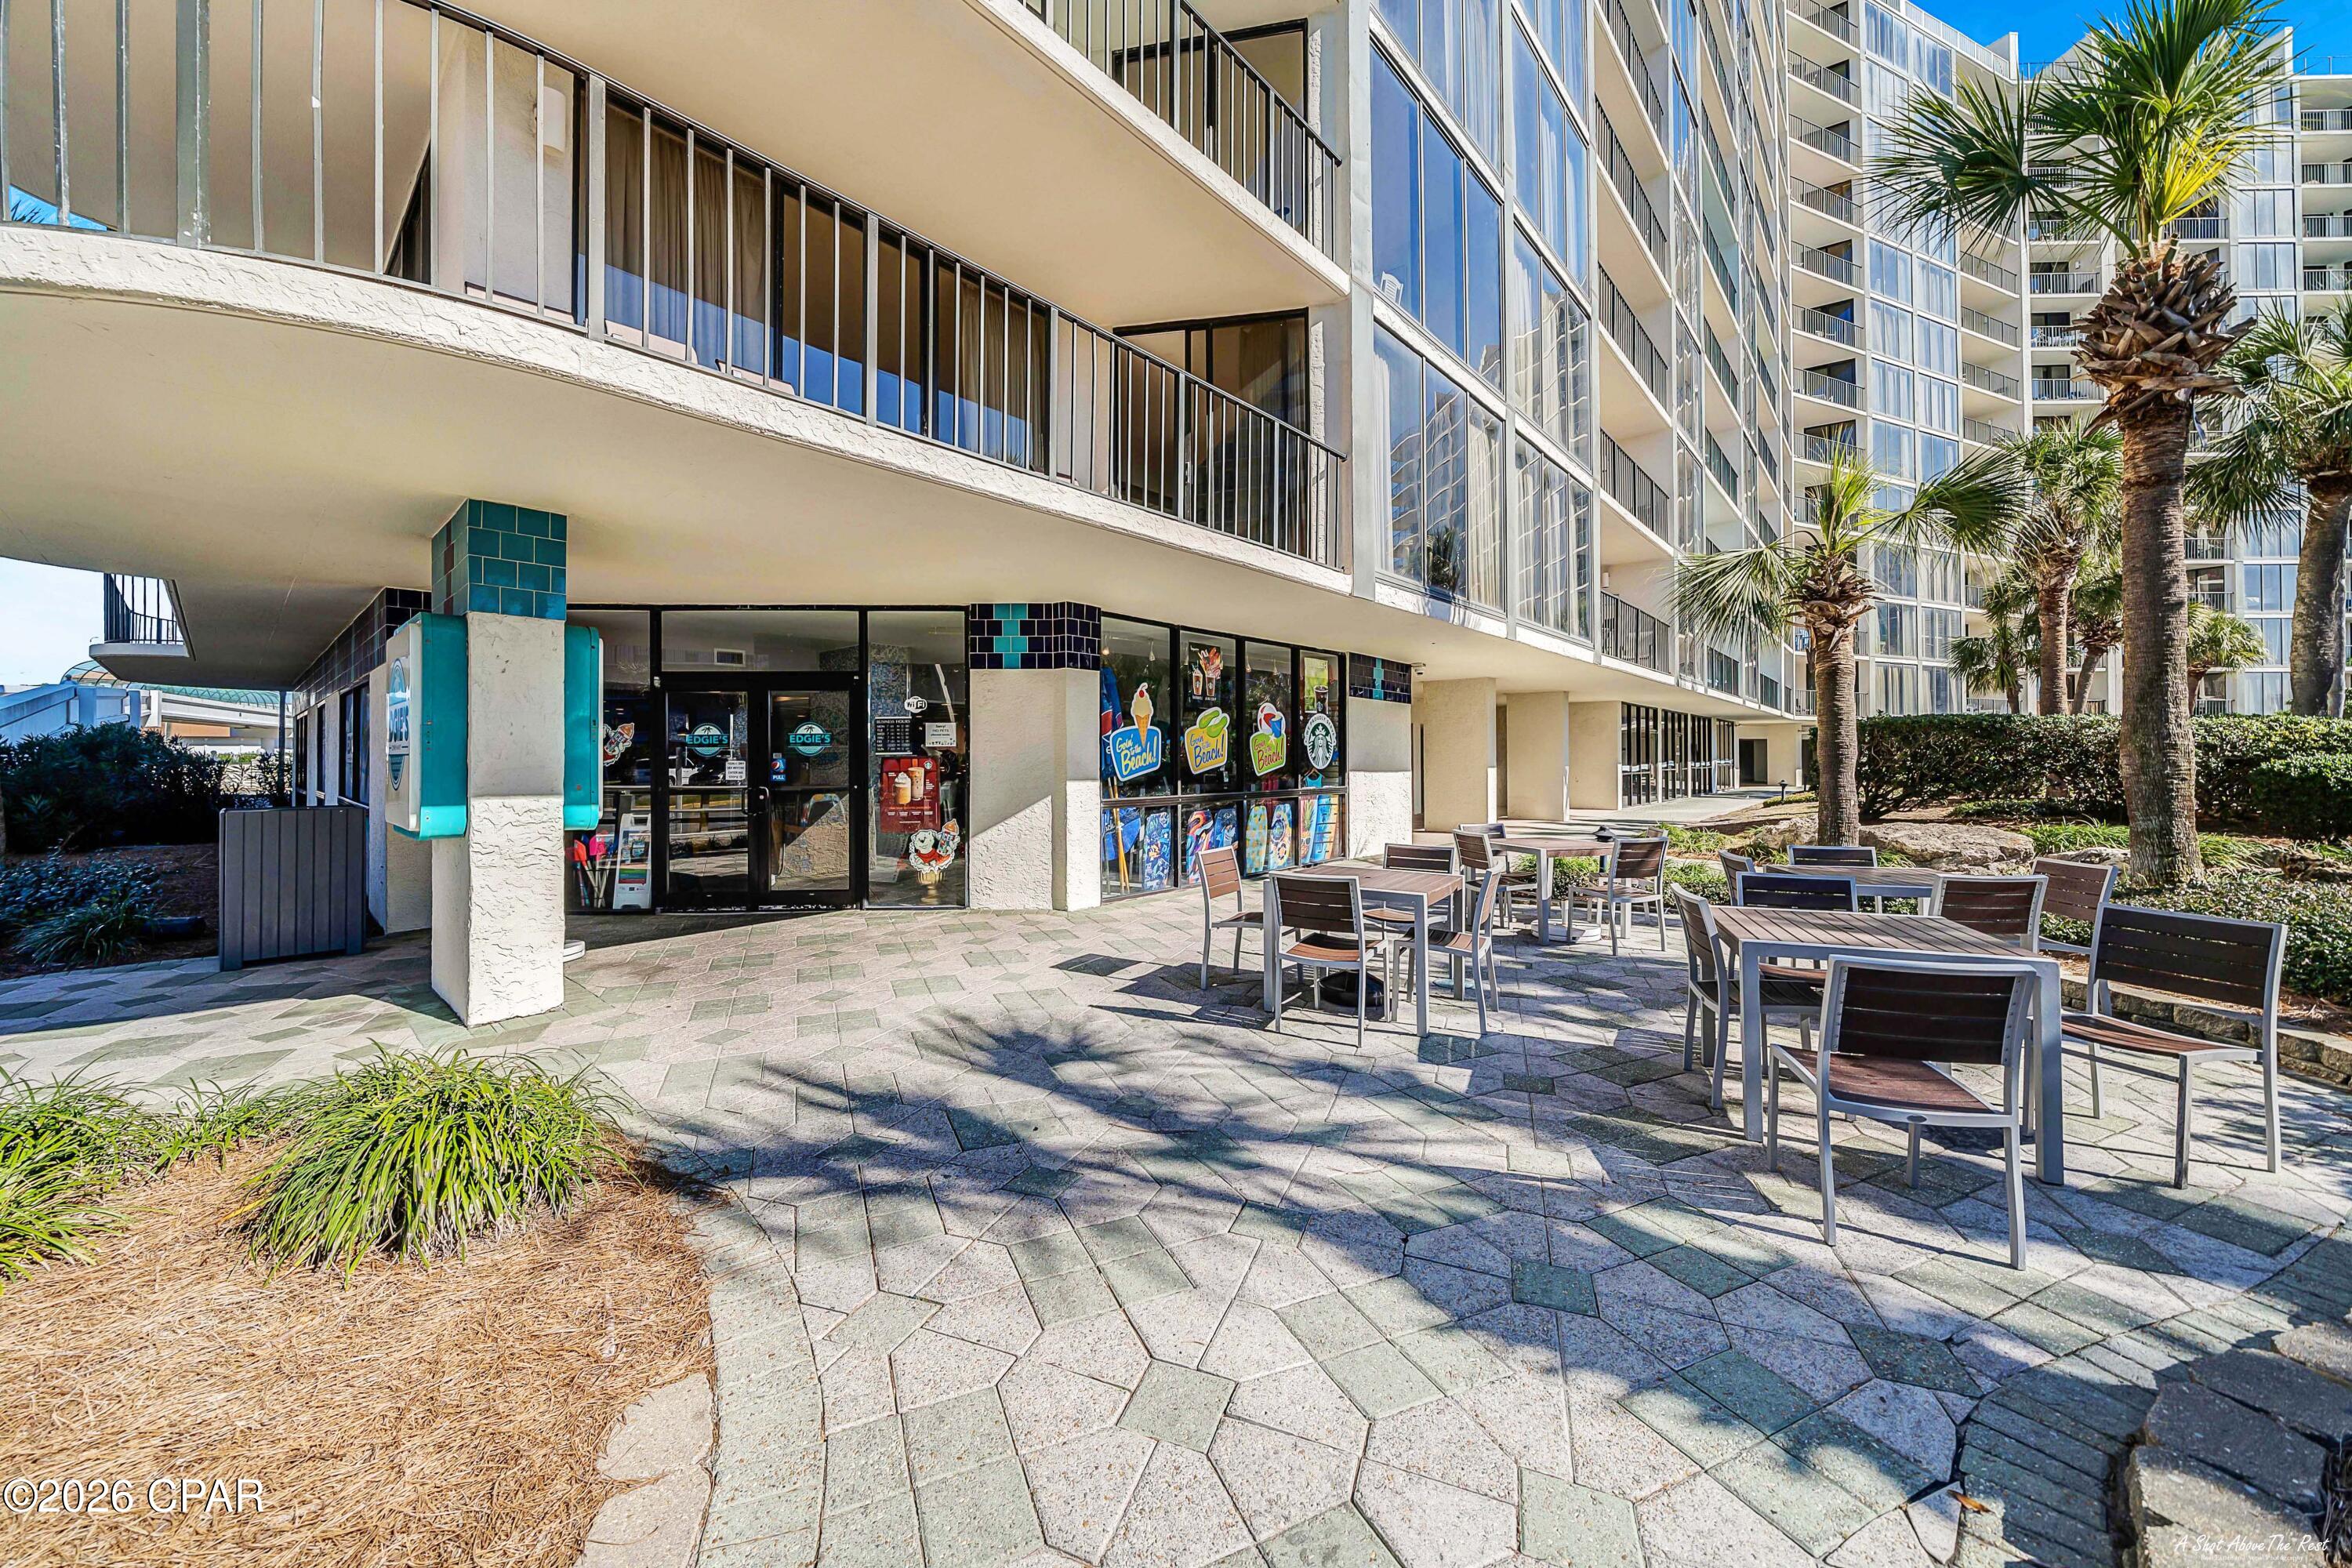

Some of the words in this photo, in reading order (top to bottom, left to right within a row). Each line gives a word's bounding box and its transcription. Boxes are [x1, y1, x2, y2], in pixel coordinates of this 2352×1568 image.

[1309, 715, 1326, 726] PROUDLY
[687, 735, 728, 744] EDGIE'S
[789, 735, 831, 743] EDGIE'S
[1116, 734, 1134, 753] Goin'
[1121, 735, 1157, 775] Beach!
[1194, 733, 1225, 768] Beach!
[1258, 736, 1283, 771] Beach!
